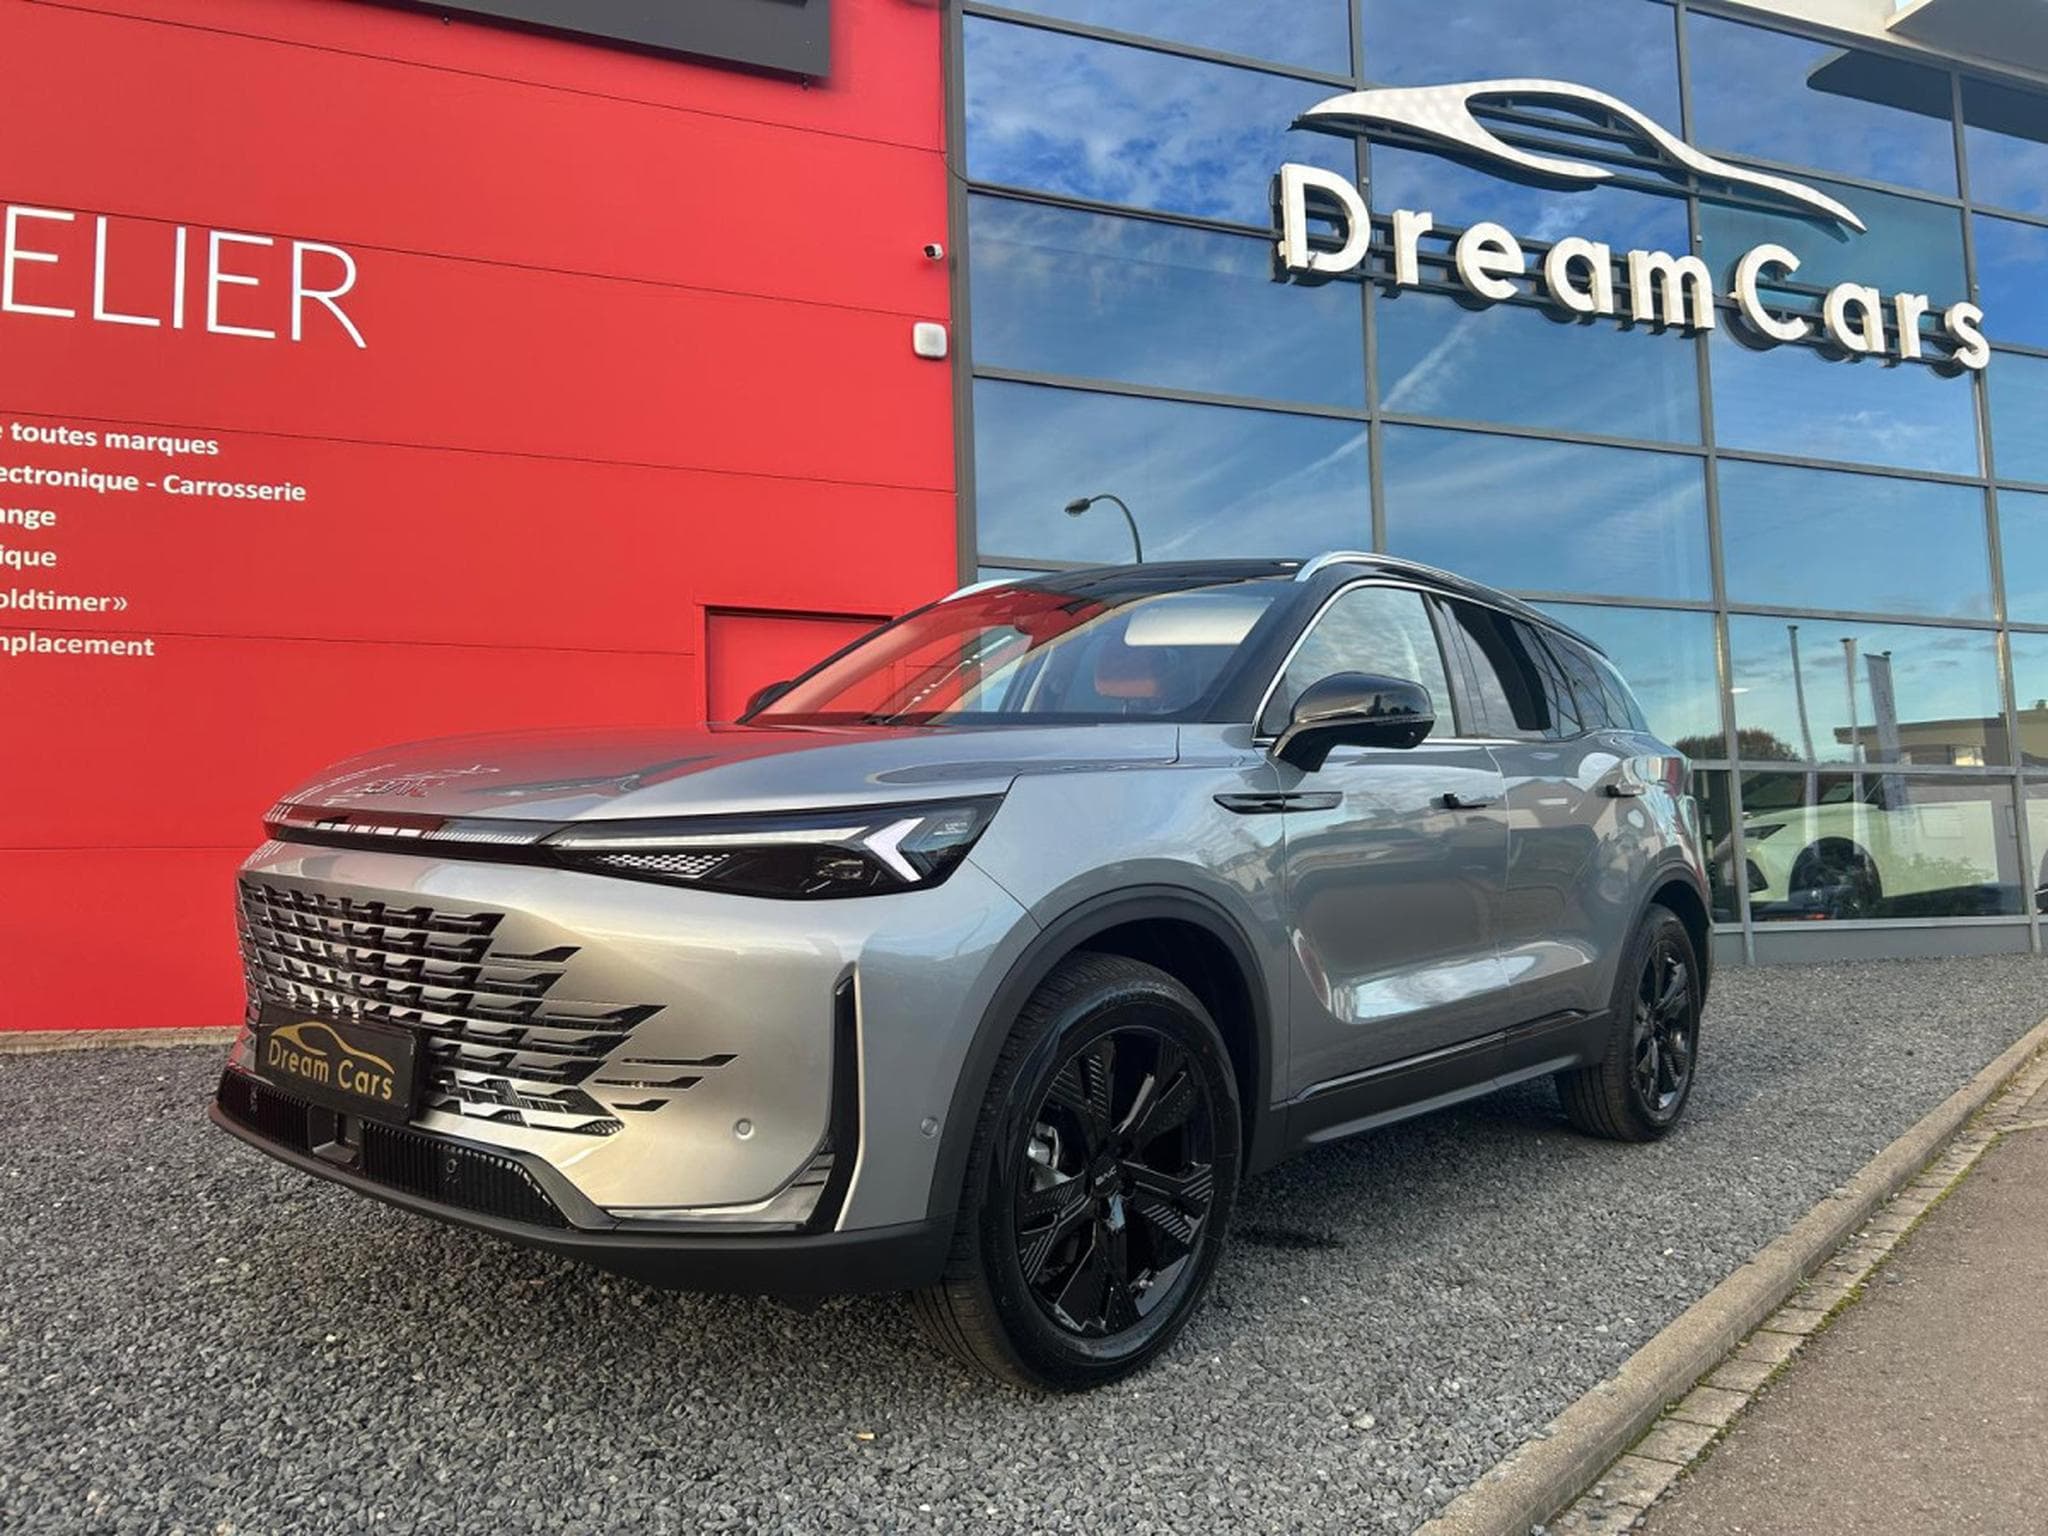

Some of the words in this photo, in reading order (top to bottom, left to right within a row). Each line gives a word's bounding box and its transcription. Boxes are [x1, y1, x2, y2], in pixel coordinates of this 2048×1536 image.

[2, 204, 367, 349] ELIER
[1280, 163, 1715, 330] Dream
[1735, 243, 1990, 370] Cars
[10, 422, 98, 447] toutes
[105, 432, 219, 456] marques
[163, 474, 307, 501] Carrosserie
[268, 1038, 329, 1083] Dream
[338, 1058, 393, 1100] Cars
